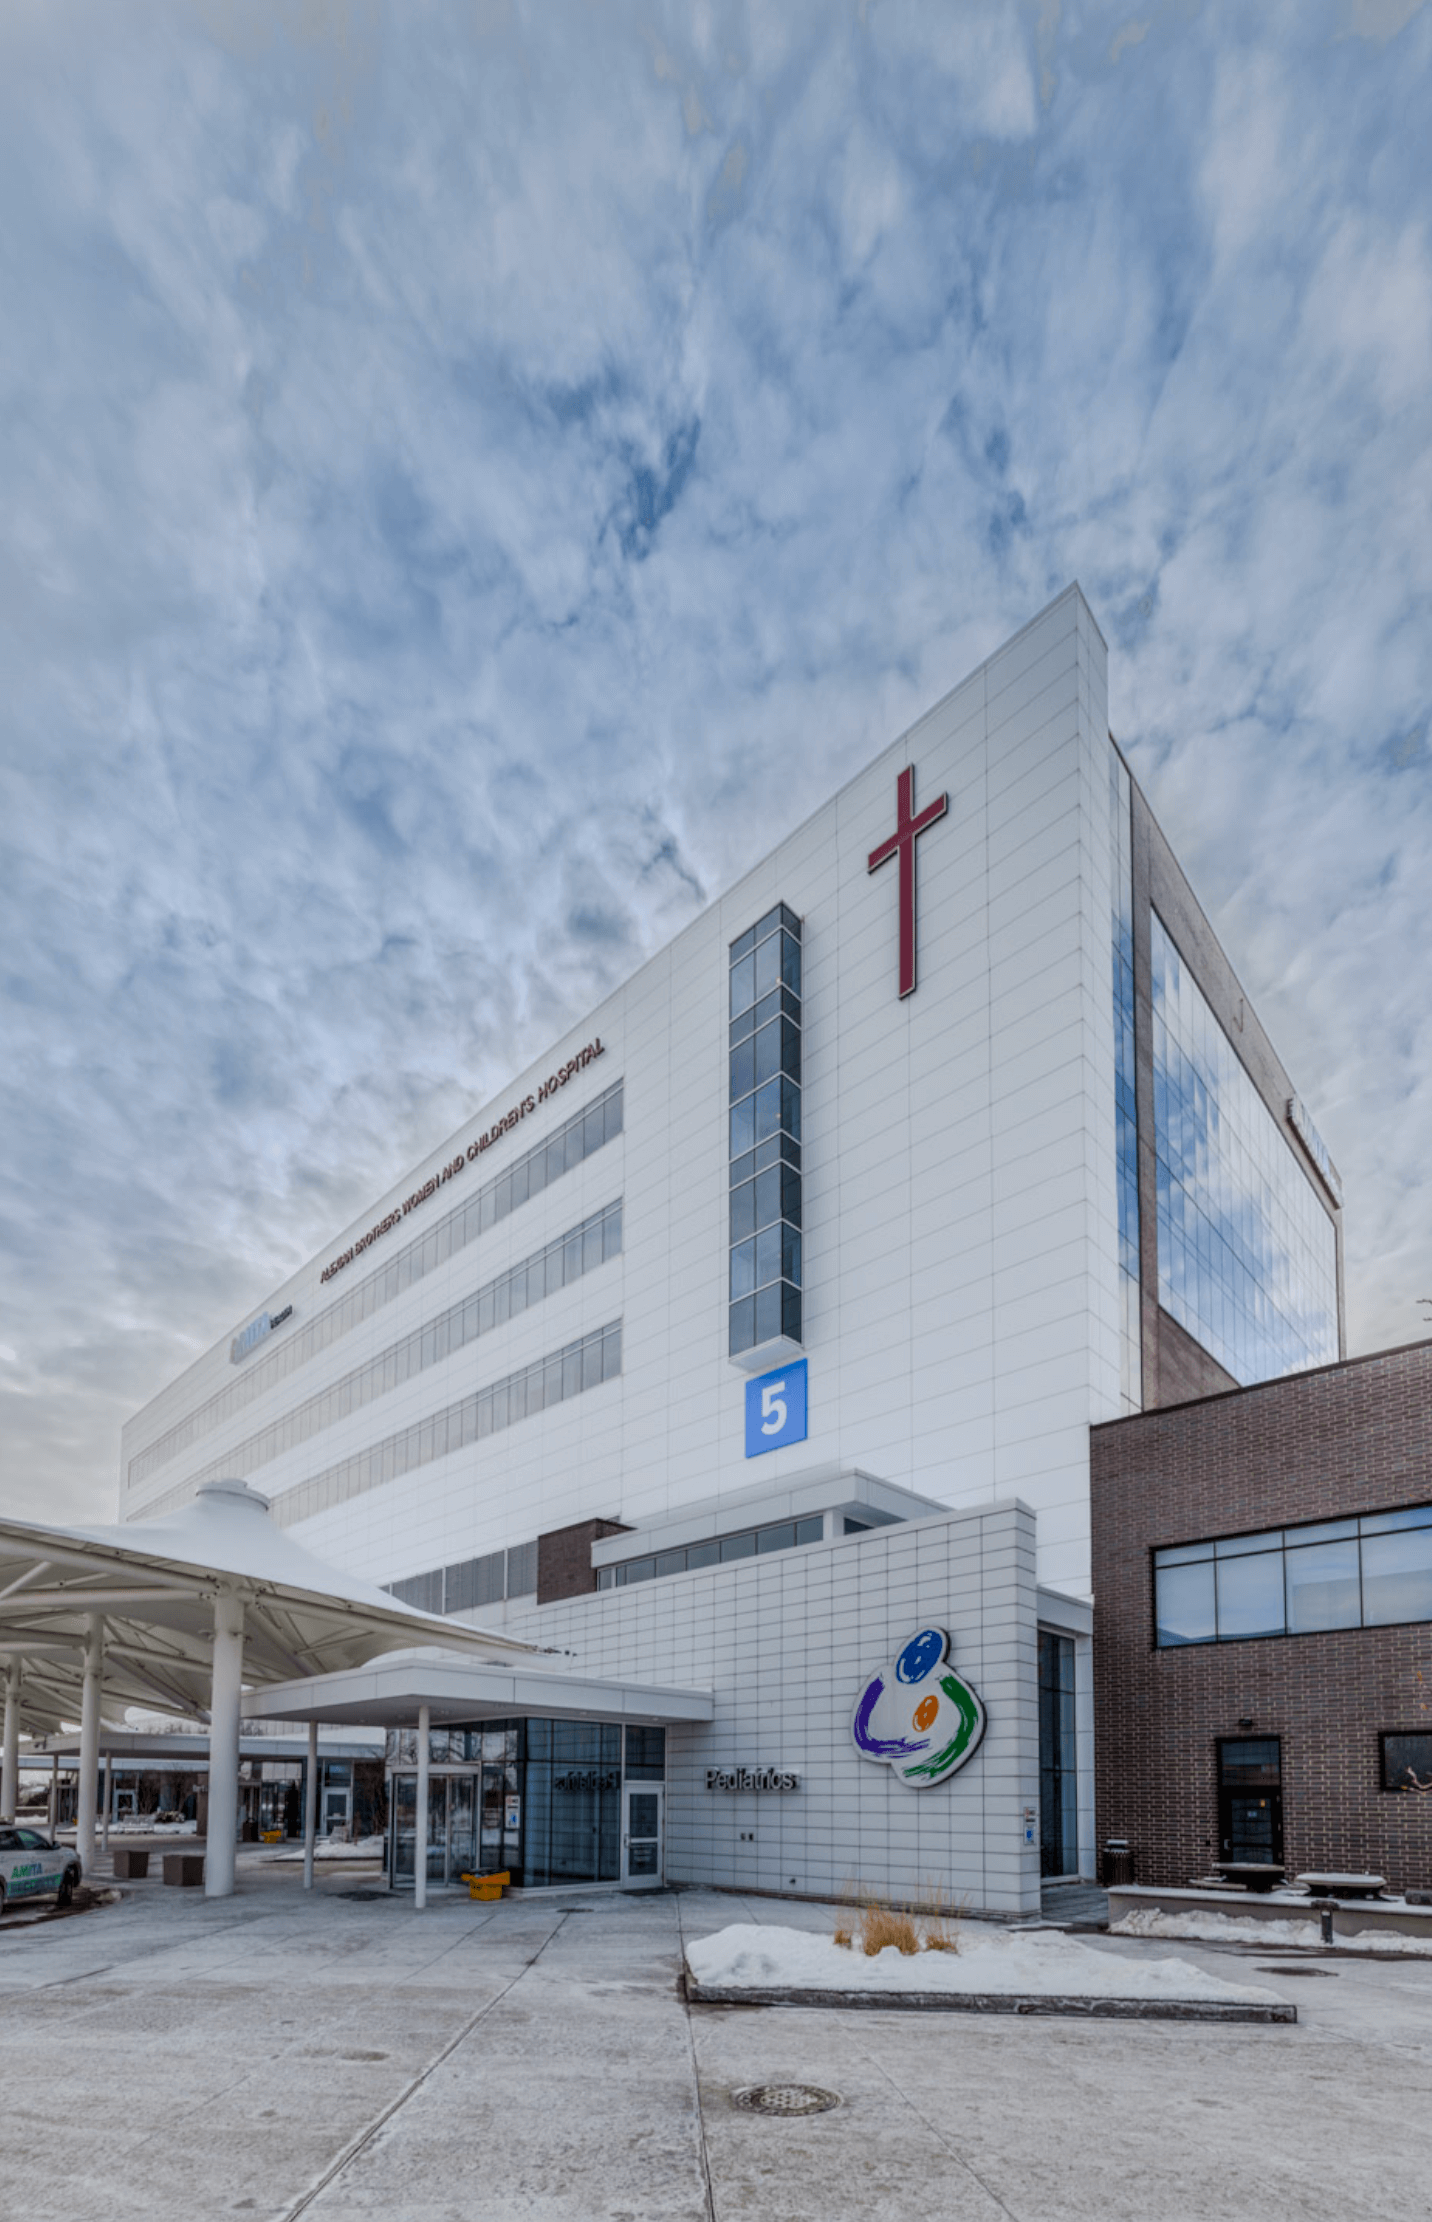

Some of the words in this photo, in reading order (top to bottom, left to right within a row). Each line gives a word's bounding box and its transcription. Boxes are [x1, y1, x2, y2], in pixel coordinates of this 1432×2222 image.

[442, 1155, 465, 1184] AND
[538, 1037, 605, 1103] HOSPITAL
[760, 1380, 787, 1435] 5
[705, 1767, 798, 1790] Pediatrics
